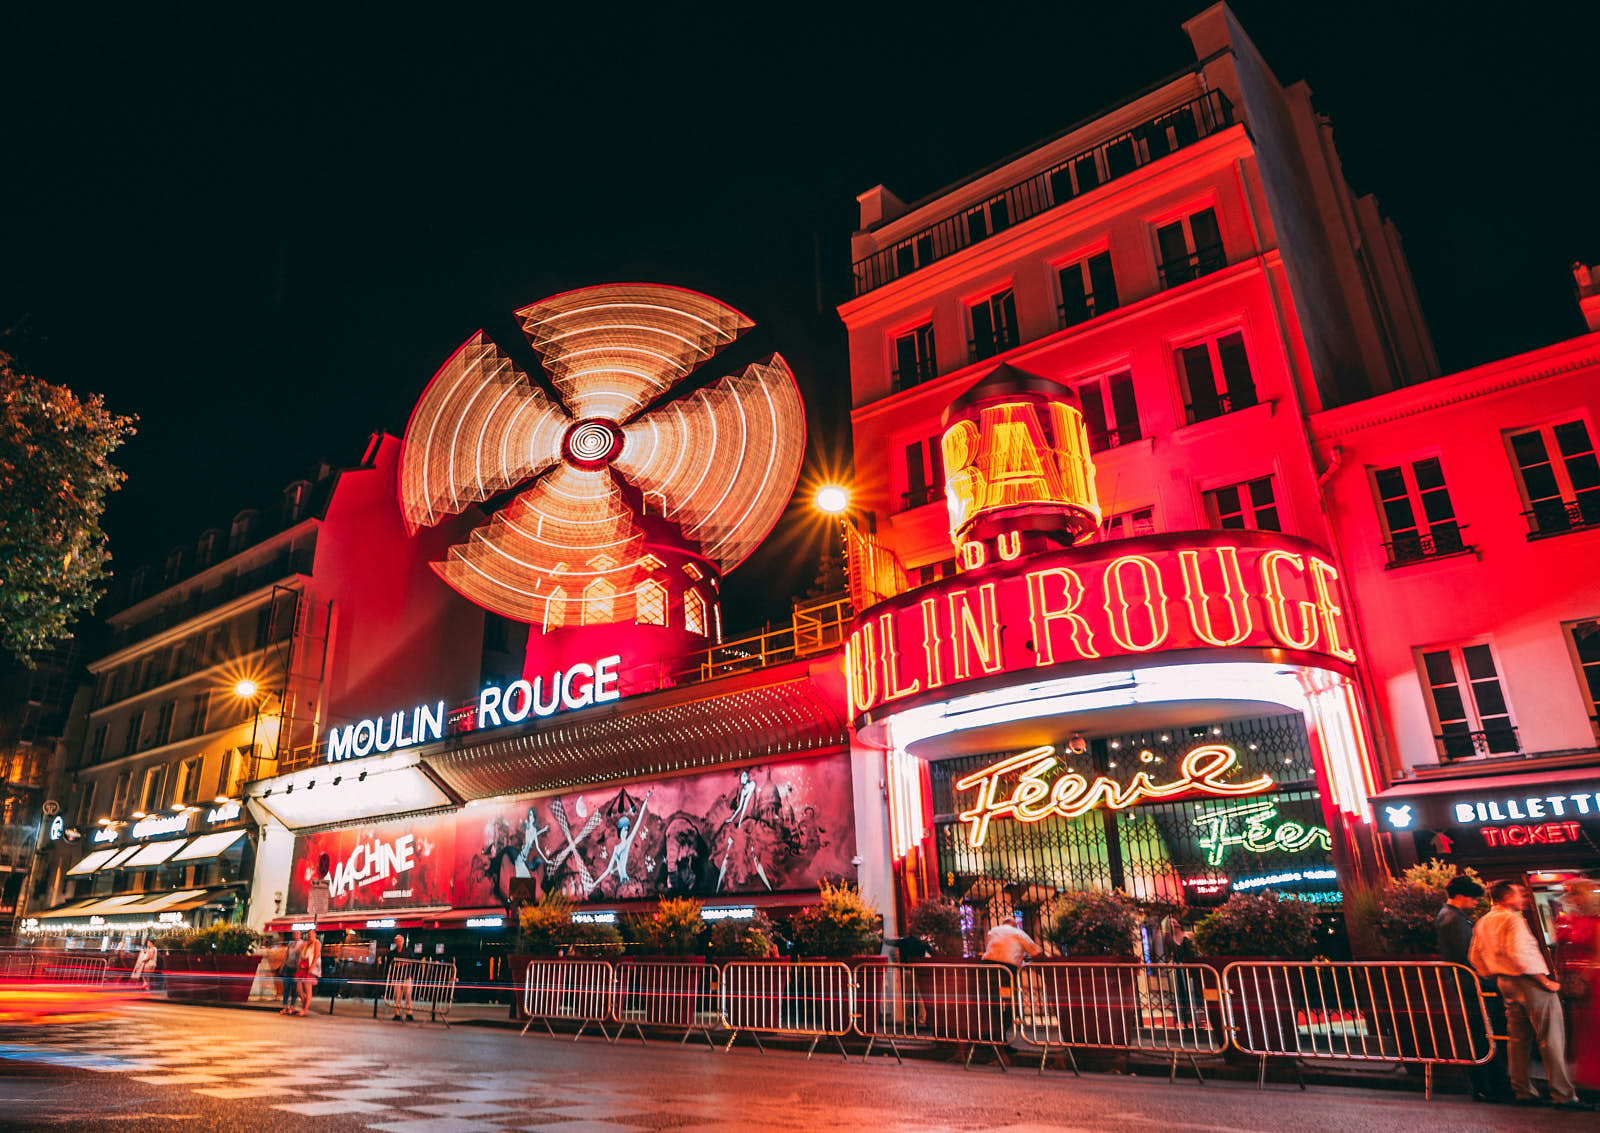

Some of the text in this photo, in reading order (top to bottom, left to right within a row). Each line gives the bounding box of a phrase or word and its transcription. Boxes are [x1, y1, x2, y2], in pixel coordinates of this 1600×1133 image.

[962, 530, 1020, 570] DU
[1025, 546, 1356, 667] ROUGE
[326, 654, 622, 763] MOULIN ROUGE
[955, 744, 1274, 848] Féerie
[1480, 821, 1582, 848] TICKET
